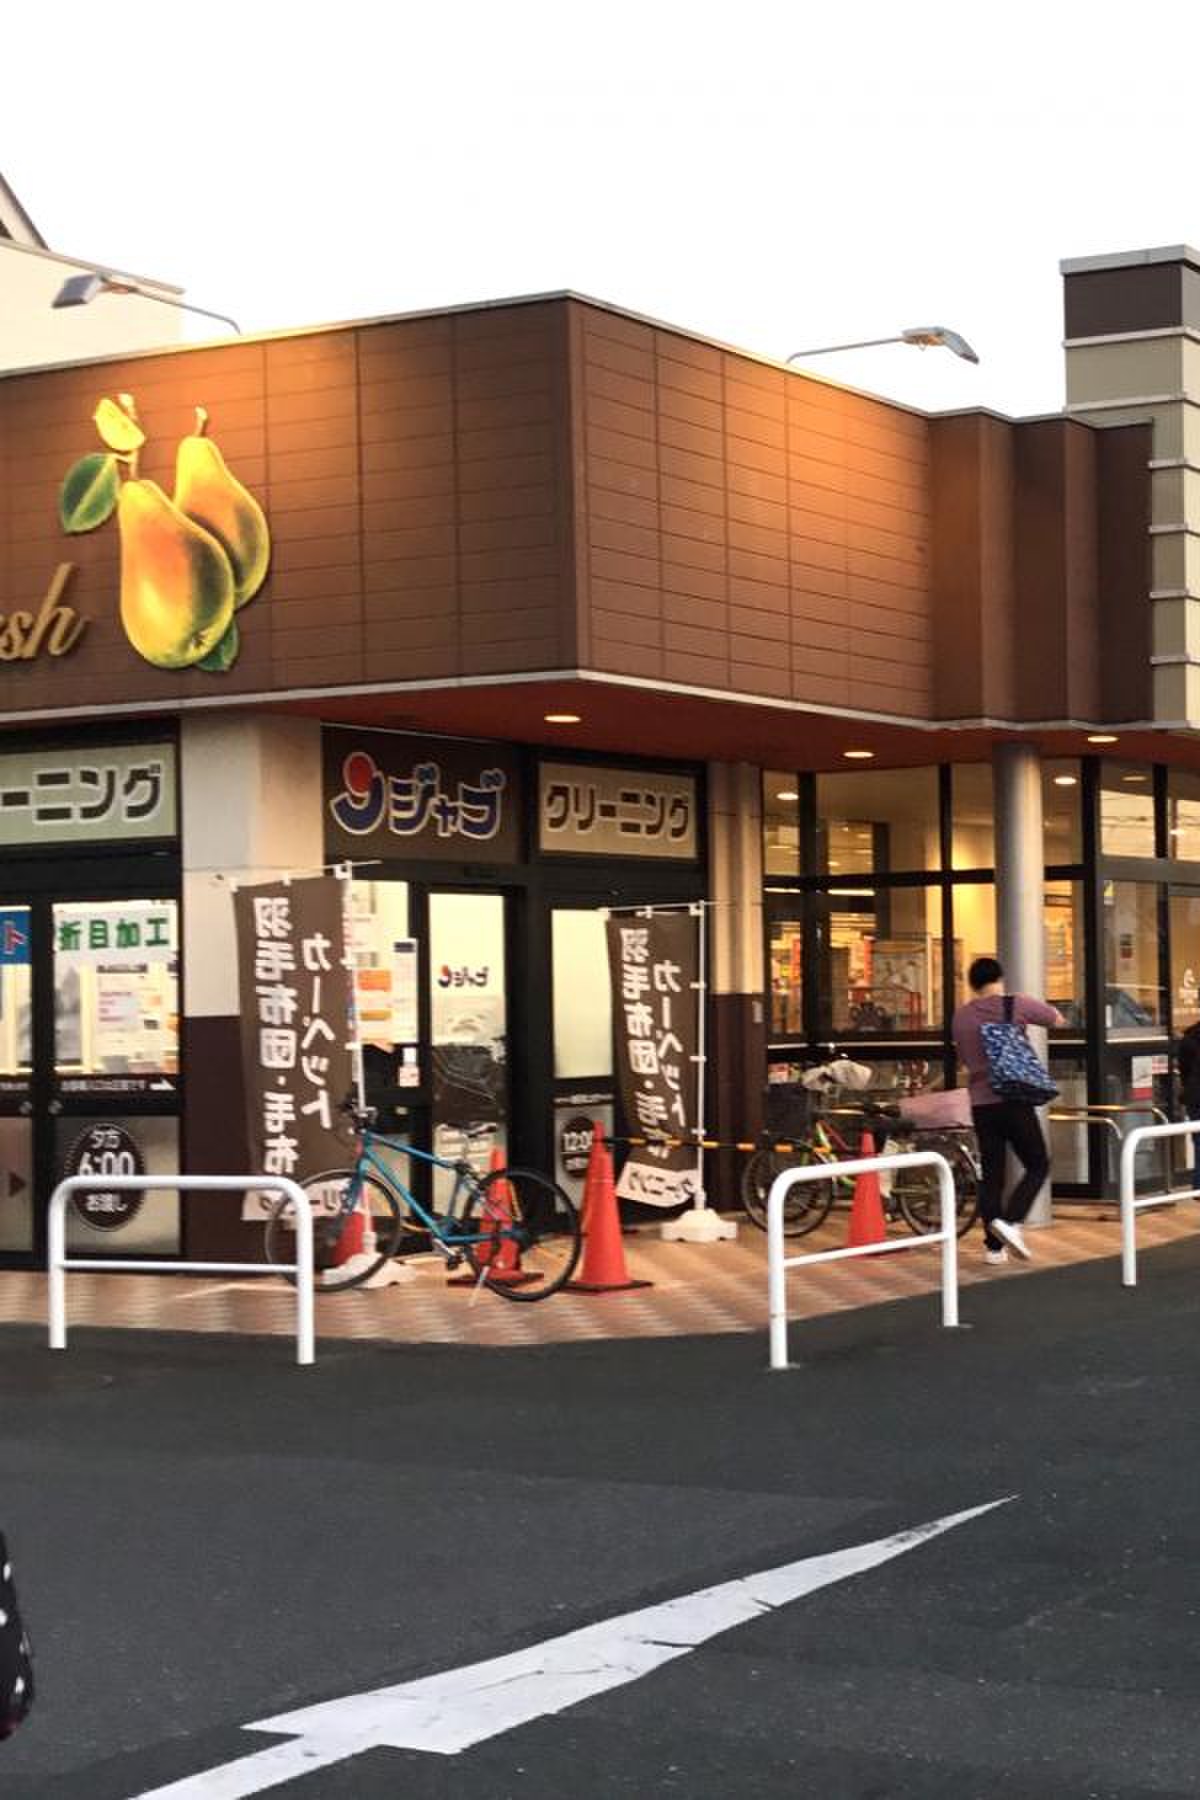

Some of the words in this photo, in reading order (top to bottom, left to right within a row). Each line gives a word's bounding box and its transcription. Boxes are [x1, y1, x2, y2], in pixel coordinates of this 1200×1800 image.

[545, 782, 691, 840] クリーニング
